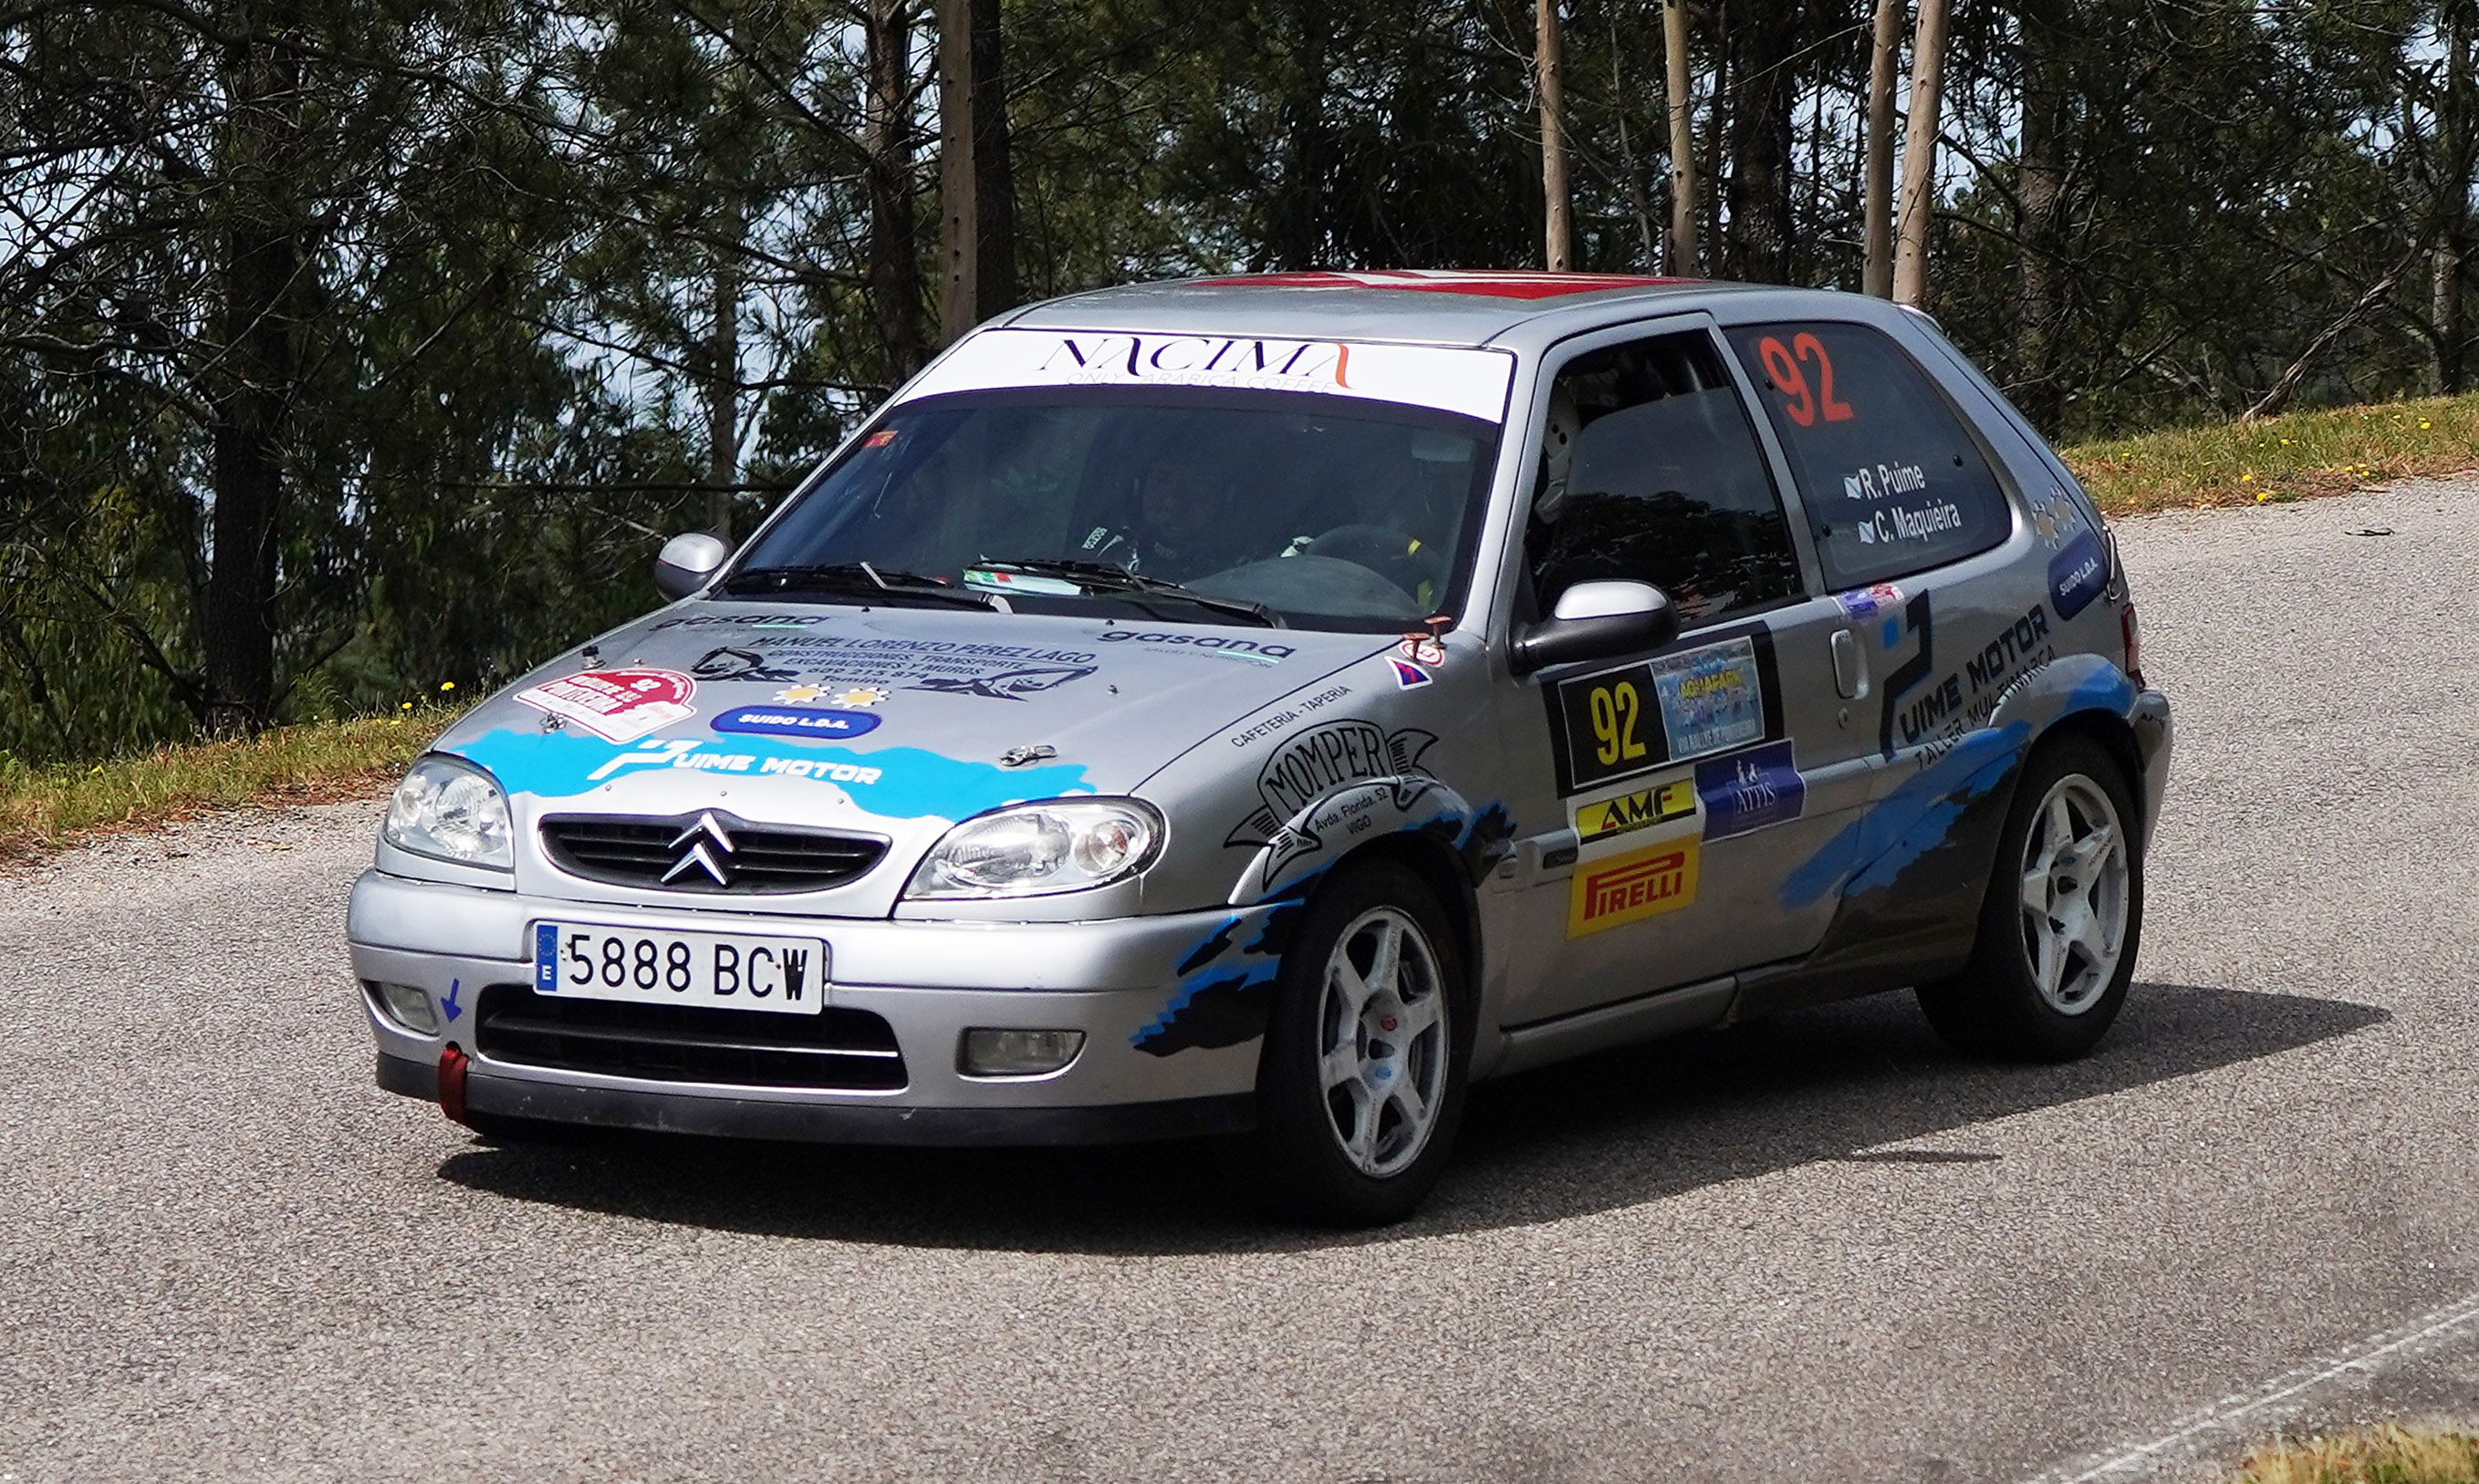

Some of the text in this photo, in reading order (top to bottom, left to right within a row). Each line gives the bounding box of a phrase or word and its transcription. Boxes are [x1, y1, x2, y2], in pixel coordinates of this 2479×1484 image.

[1037, 336, 1355, 389] NACIMA
[1759, 332, 1854, 427] 92
[1859, 461, 1925, 499] R. Puime
[1875, 498, 1962, 542] C. Maquieira
[748, 637, 844, 648] MANUEL
[845, 638, 955, 652] LORENZO
[1028, 649, 1097, 663] LAGO
[1097, 630, 1297, 659] gasana
[1965, 604, 2049, 693] MOTOR
[1589, 681, 1646, 766] 92
[1915, 718, 1966, 770] TALLER
[759, 757, 882, 785] MOTOR
[1266, 727, 1390, 816] MOMPER
[1601, 785, 1672, 830] AMF
[1736, 782, 1776, 814] ATTIS
[1346, 815, 1371, 835] VIGO
[1583, 851, 1685, 920] PIRELLI
[541, 965, 552, 981] E
[568, 934, 807, 1001] 5888 BCW
